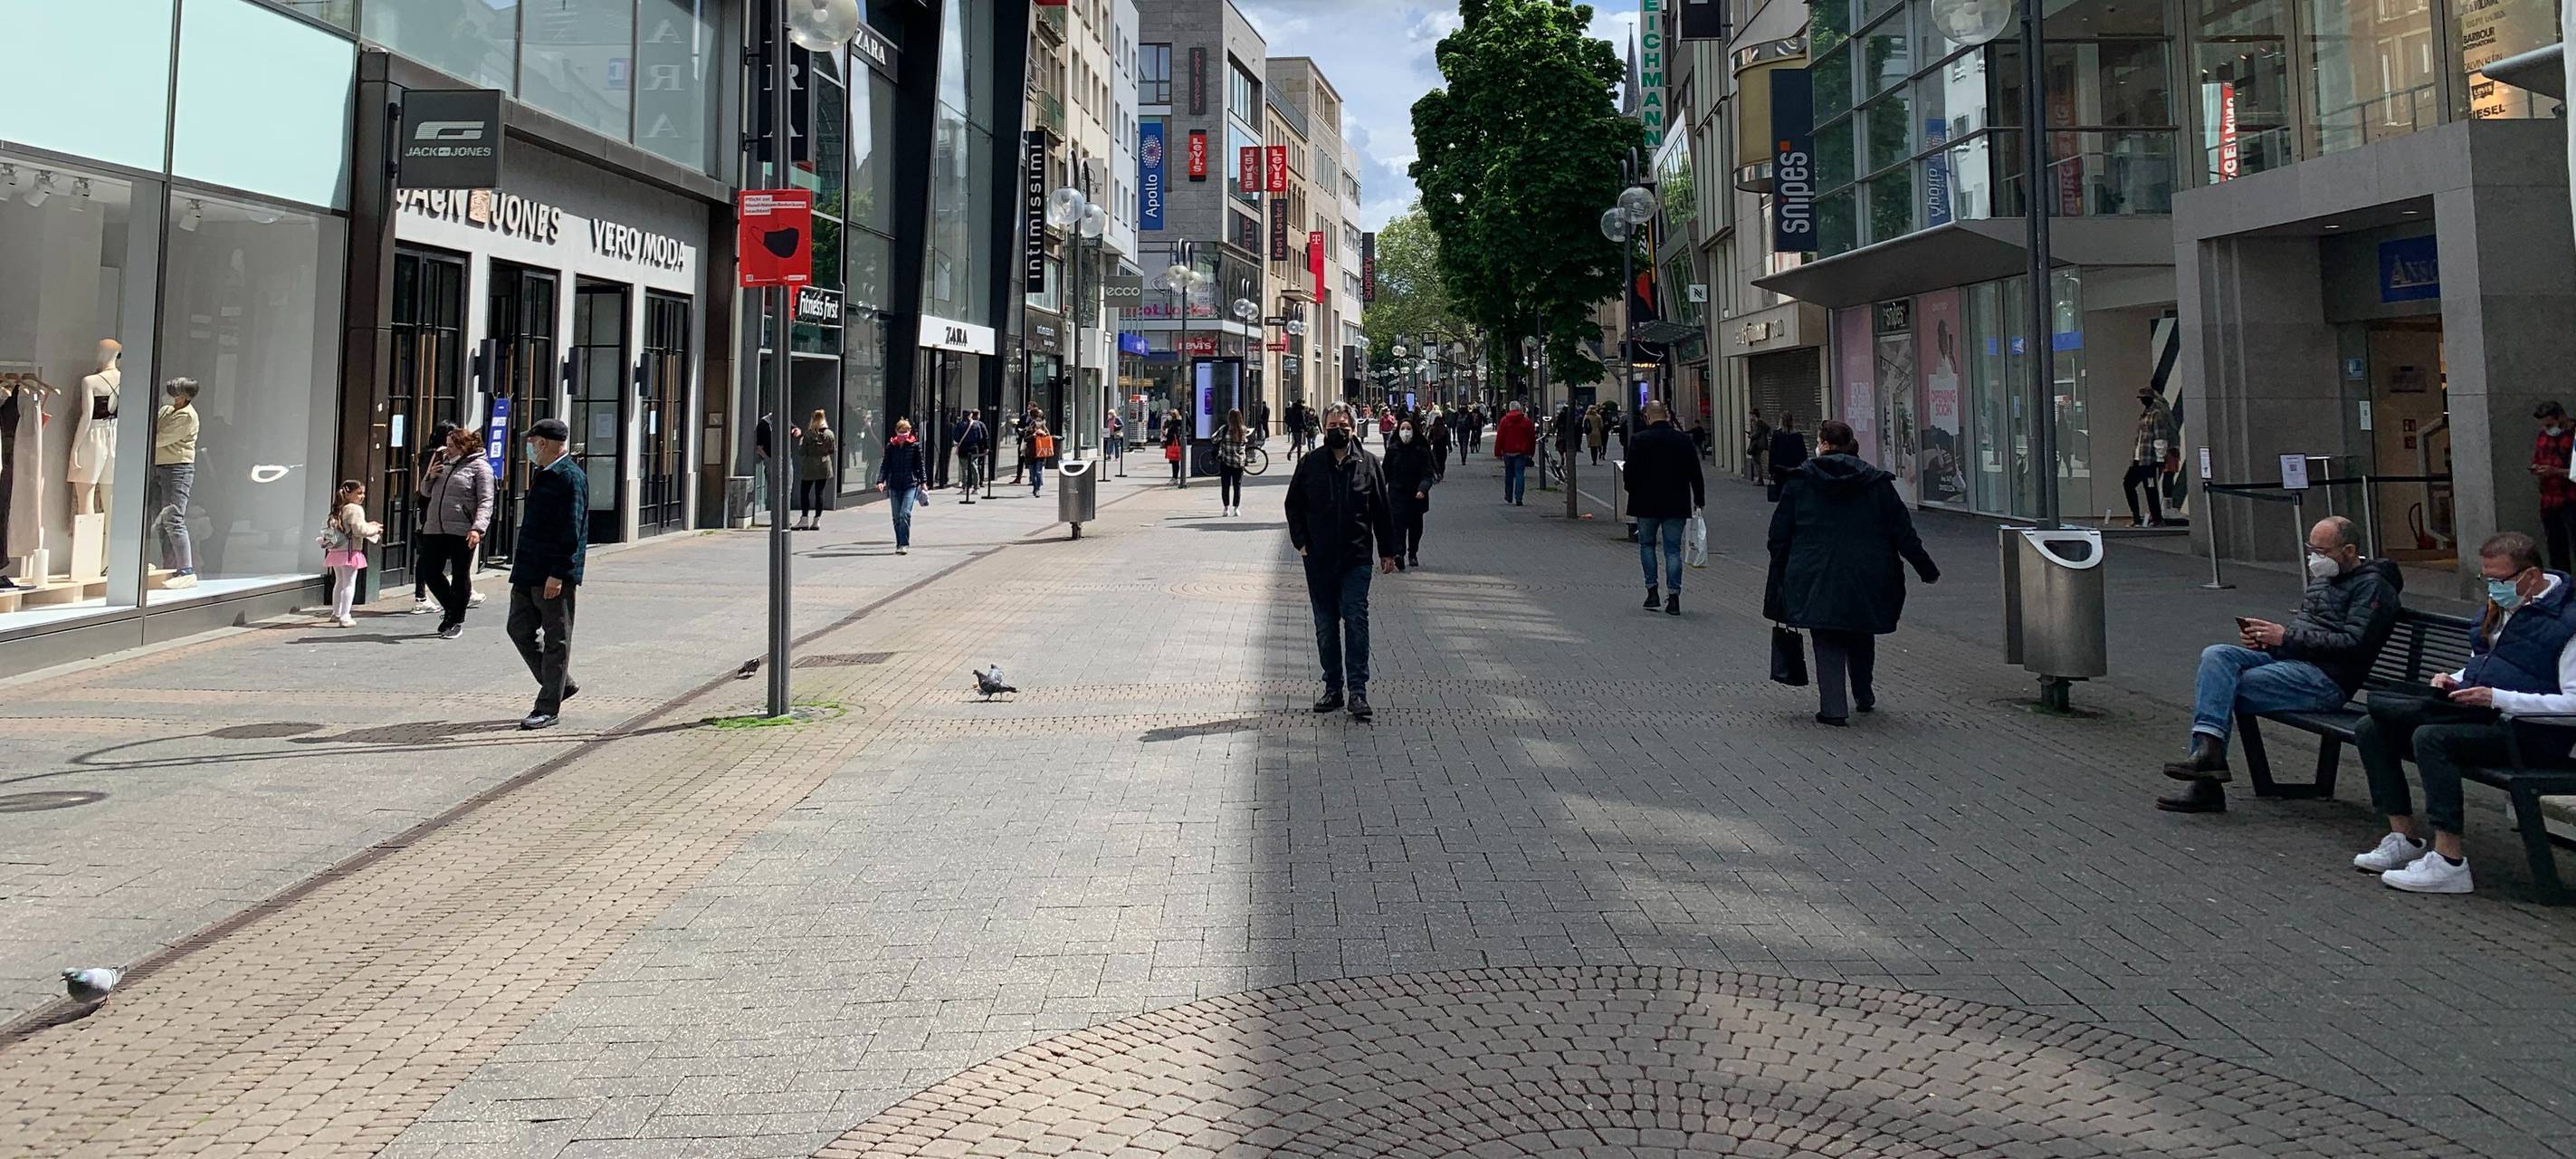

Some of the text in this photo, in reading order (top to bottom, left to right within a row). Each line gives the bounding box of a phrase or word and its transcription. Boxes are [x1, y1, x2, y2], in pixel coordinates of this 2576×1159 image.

[854, 28, 886, 66] ZARA
[2463, 26, 2495, 44] BARBOUR
[405, 147, 439, 157] JACK
[450, 147, 491, 157] JONES
[1028, 144, 1043, 279] intimissimi
[1144, 174, 1161, 218] Apollo
[1779, 151, 1816, 234] snipes
[491, 192, 563, 240] JONES
[1274, 203, 1283, 258] Foot Locker
[593, 218, 686, 268] VERO MODA
[1105, 287, 1140, 296] ecco
[1166, 302, 1215, 315] Loker
[946, 326, 968, 346] ZARA
